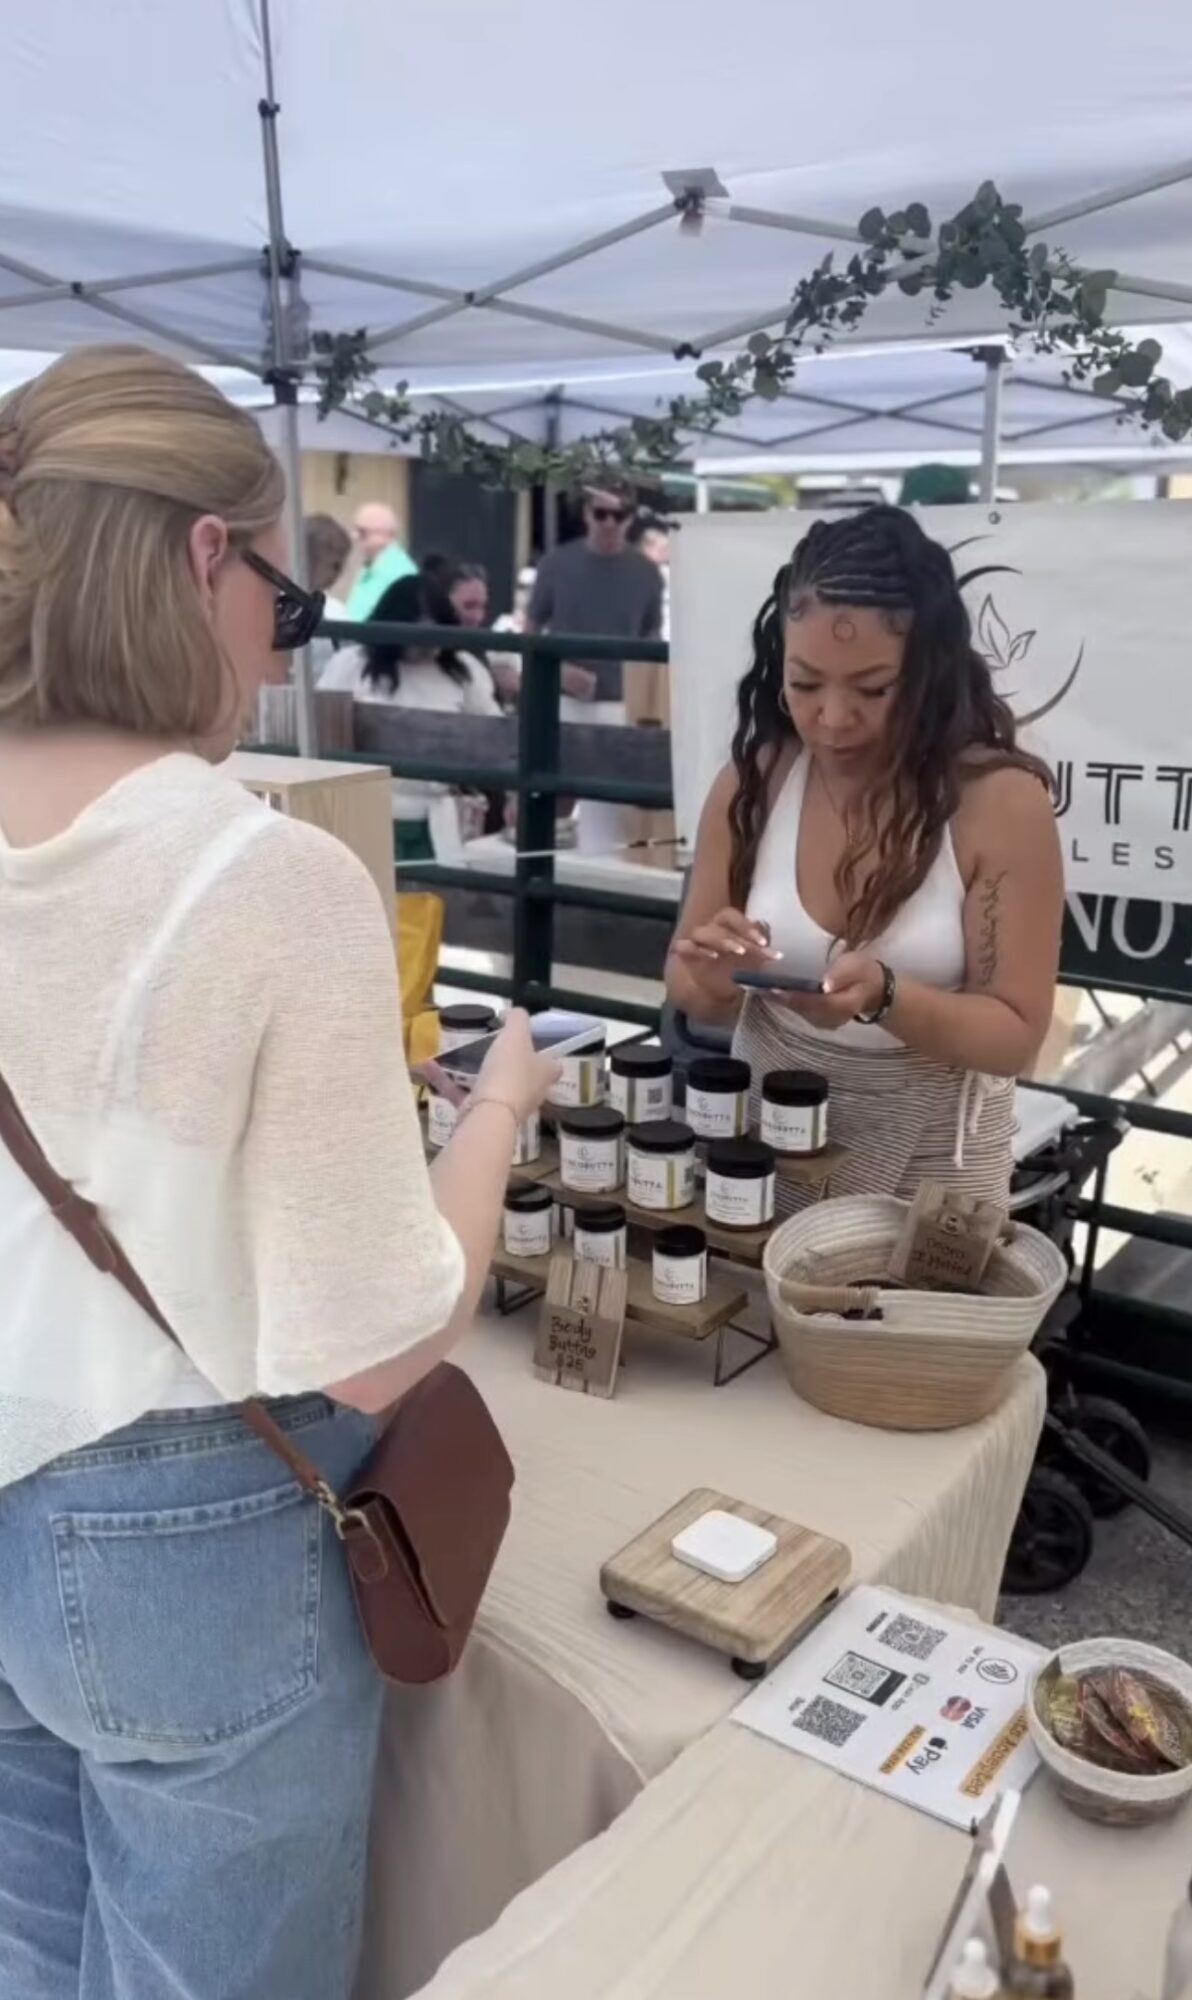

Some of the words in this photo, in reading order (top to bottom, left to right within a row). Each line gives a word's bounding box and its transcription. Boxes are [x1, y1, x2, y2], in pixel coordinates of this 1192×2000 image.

[551, 1315, 592, 1344] Body
[960, 1706, 989, 1730] VISA
[905, 1746, 942, 1776] Pay
[963, 1737, 1017, 1797] Accepted
